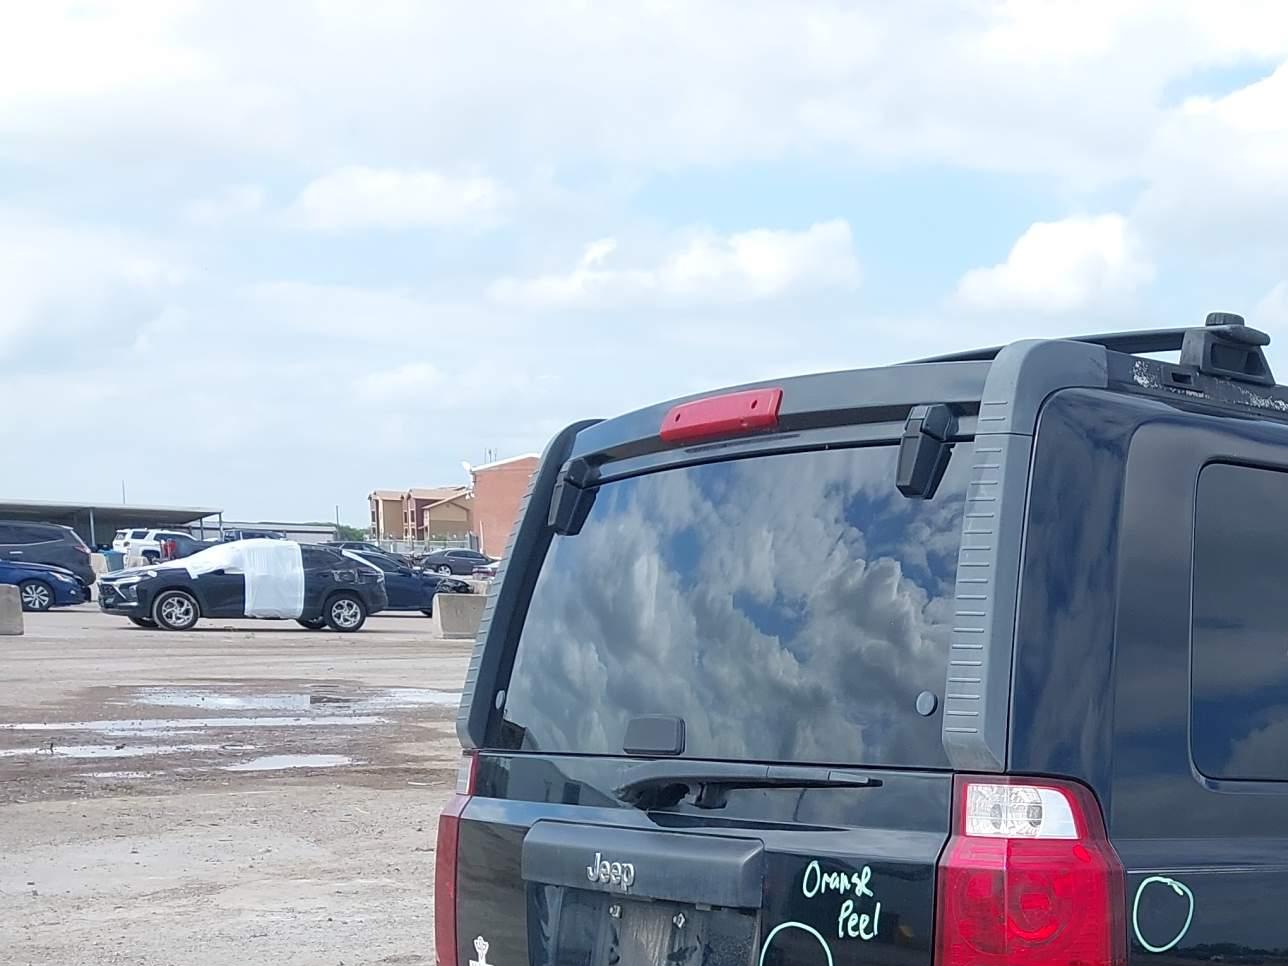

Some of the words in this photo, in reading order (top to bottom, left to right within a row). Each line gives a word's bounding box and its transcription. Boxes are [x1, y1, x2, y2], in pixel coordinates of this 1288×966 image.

[586, 852, 635, 893] Jeep
[802, 860, 874, 898] Orange
[838, 899, 881, 940] Peel
